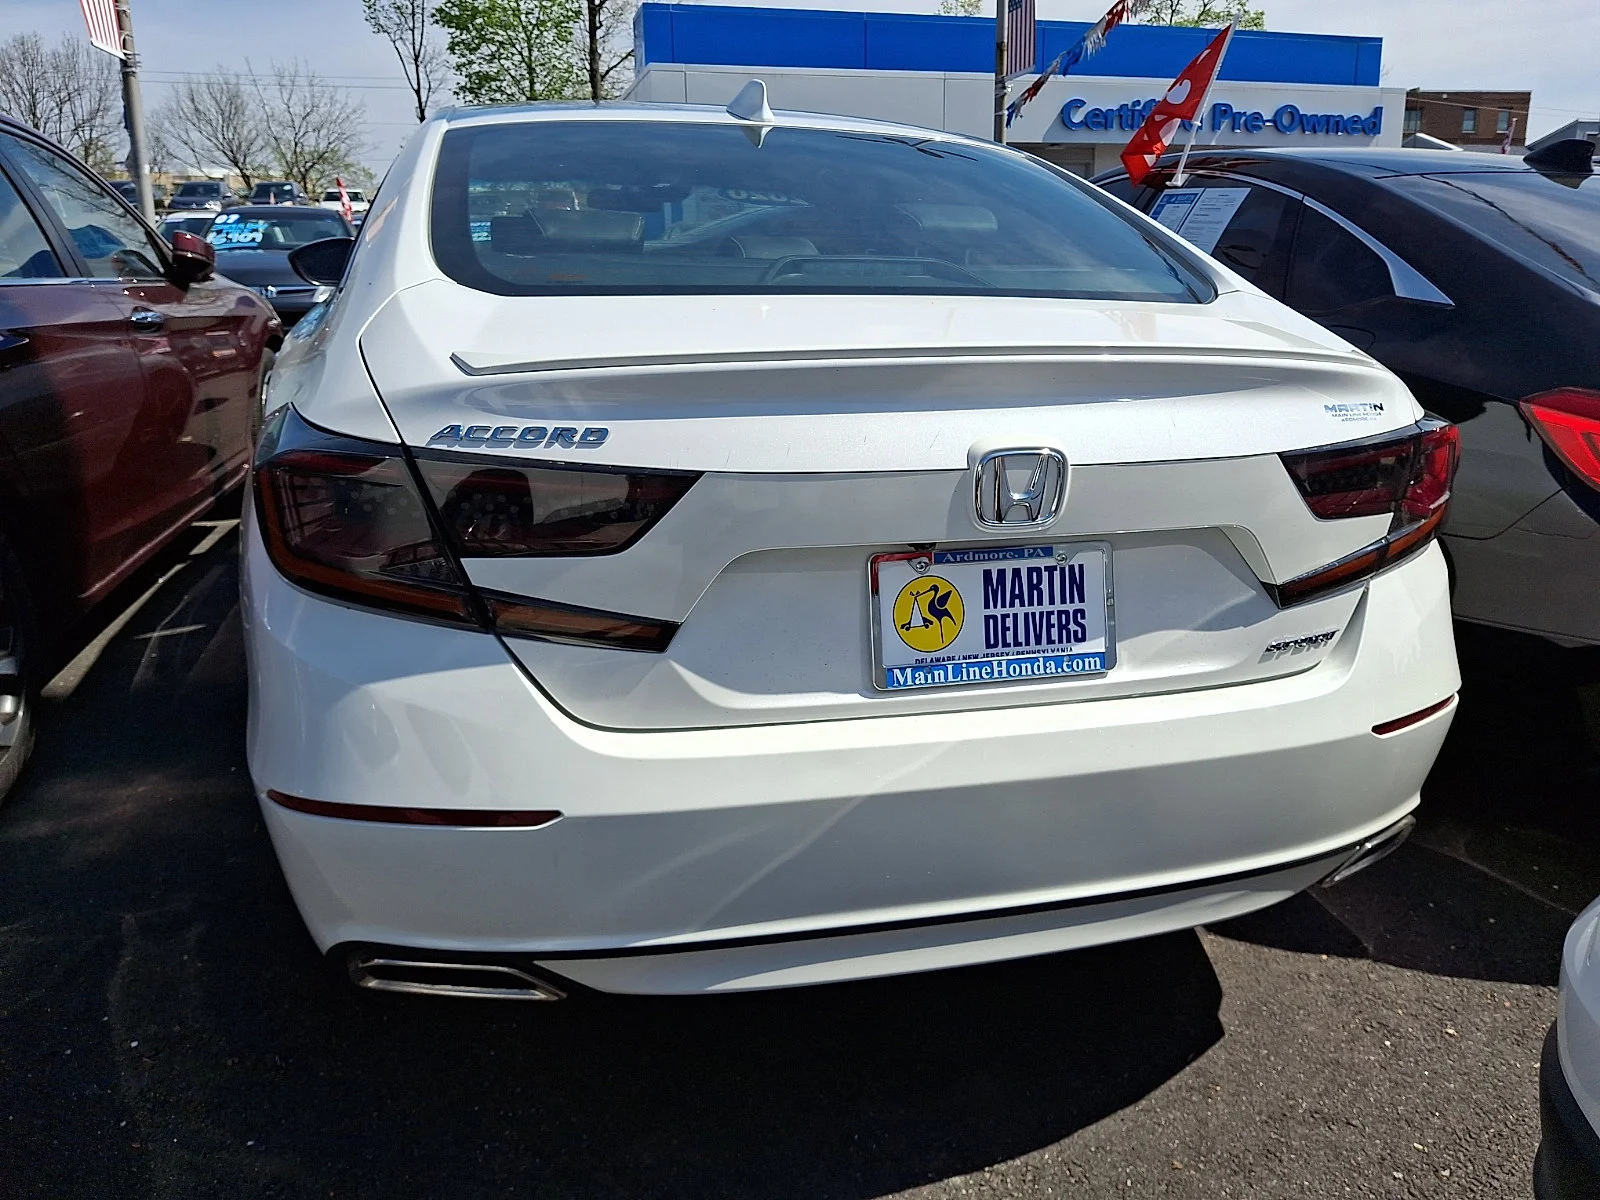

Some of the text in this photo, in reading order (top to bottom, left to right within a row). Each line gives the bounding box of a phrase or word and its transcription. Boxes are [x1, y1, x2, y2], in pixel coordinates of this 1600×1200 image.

[1212, 102, 1383, 136] Pre-Owned
[1324, 402, 1384, 413] MARTIN
[430, 423, 610, 444] ACCORD
[1024, 548, 1045, 558] PA
[982, 563, 1086, 610] MARTIN
[983, 608, 1087, 650] DELIVERS
[892, 655, 1101, 688] MainLineHonda.com
